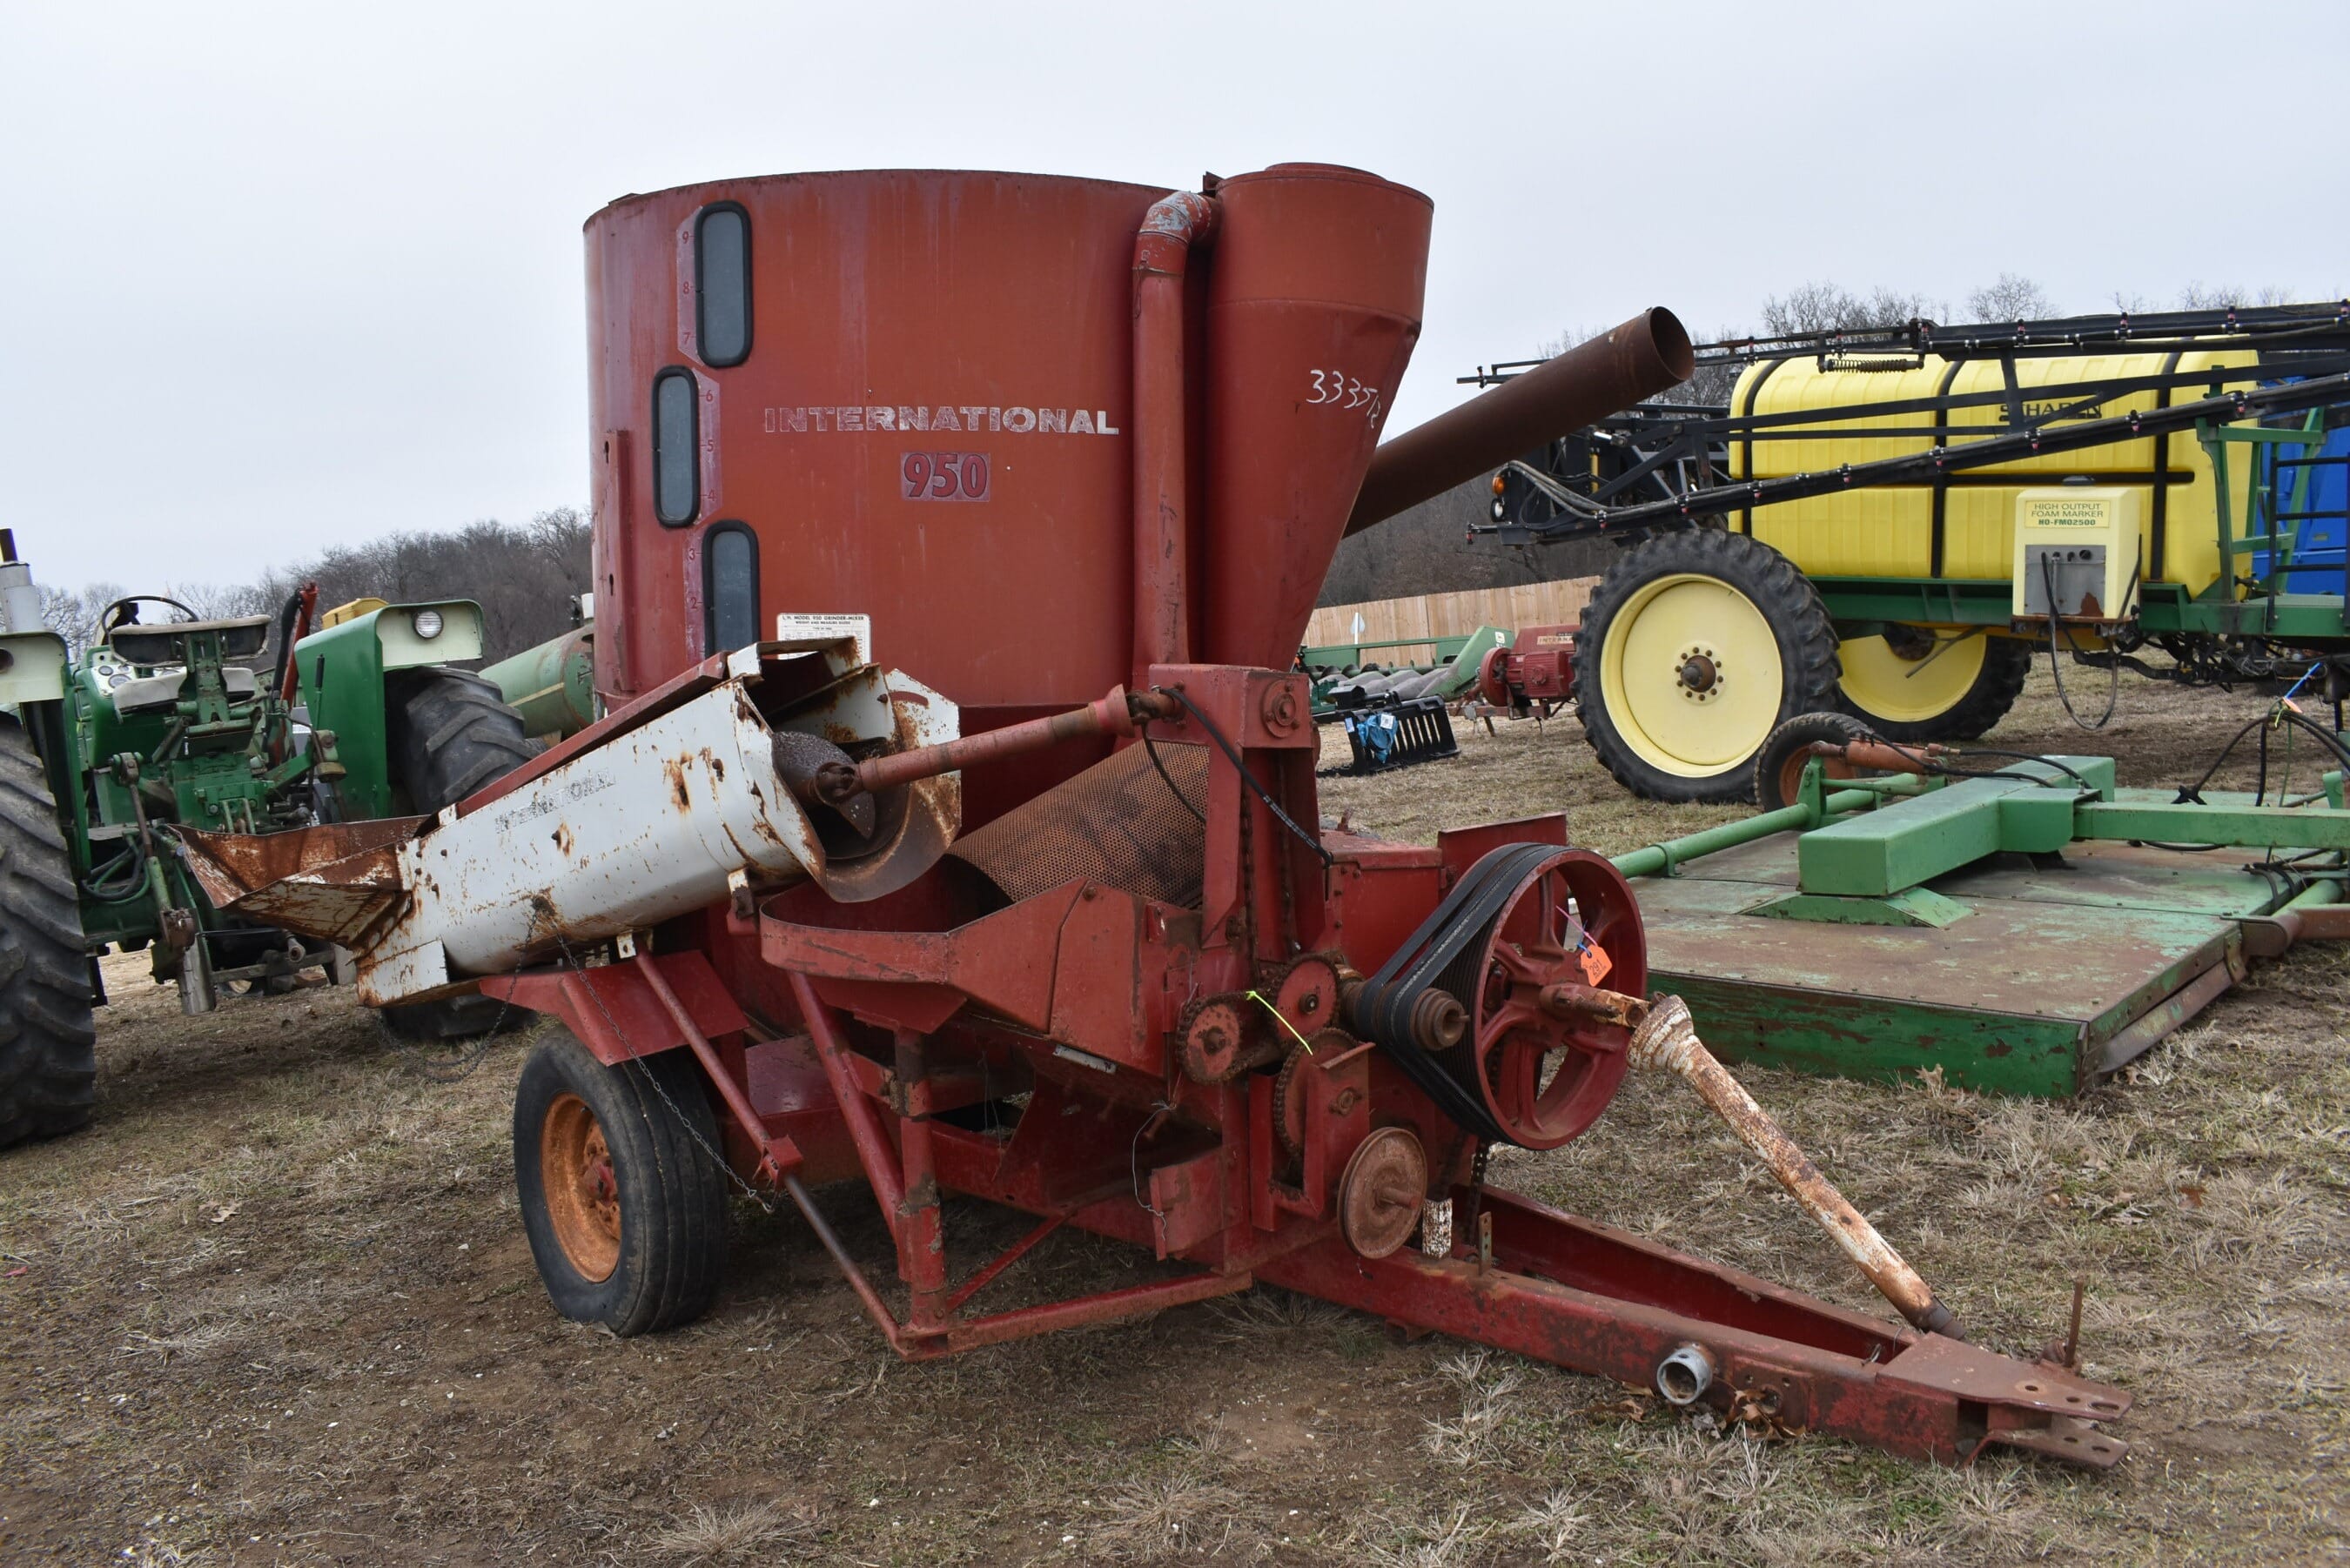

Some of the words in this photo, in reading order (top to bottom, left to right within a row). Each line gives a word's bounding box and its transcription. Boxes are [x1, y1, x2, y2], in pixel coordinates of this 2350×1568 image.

[682, 231, 689, 245] 9
[682, 281, 690, 295] 8
[683, 332, 690, 345] 7
[705, 390, 714, 403] 6
[763, 405, 1120, 435] INTERNATIONAL
[707, 439, 714, 452] 5
[903, 452, 988, 499] 950
[707, 489, 716, 502] 4
[688, 547, 696, 560] 3
[690, 597, 697, 609] 2
